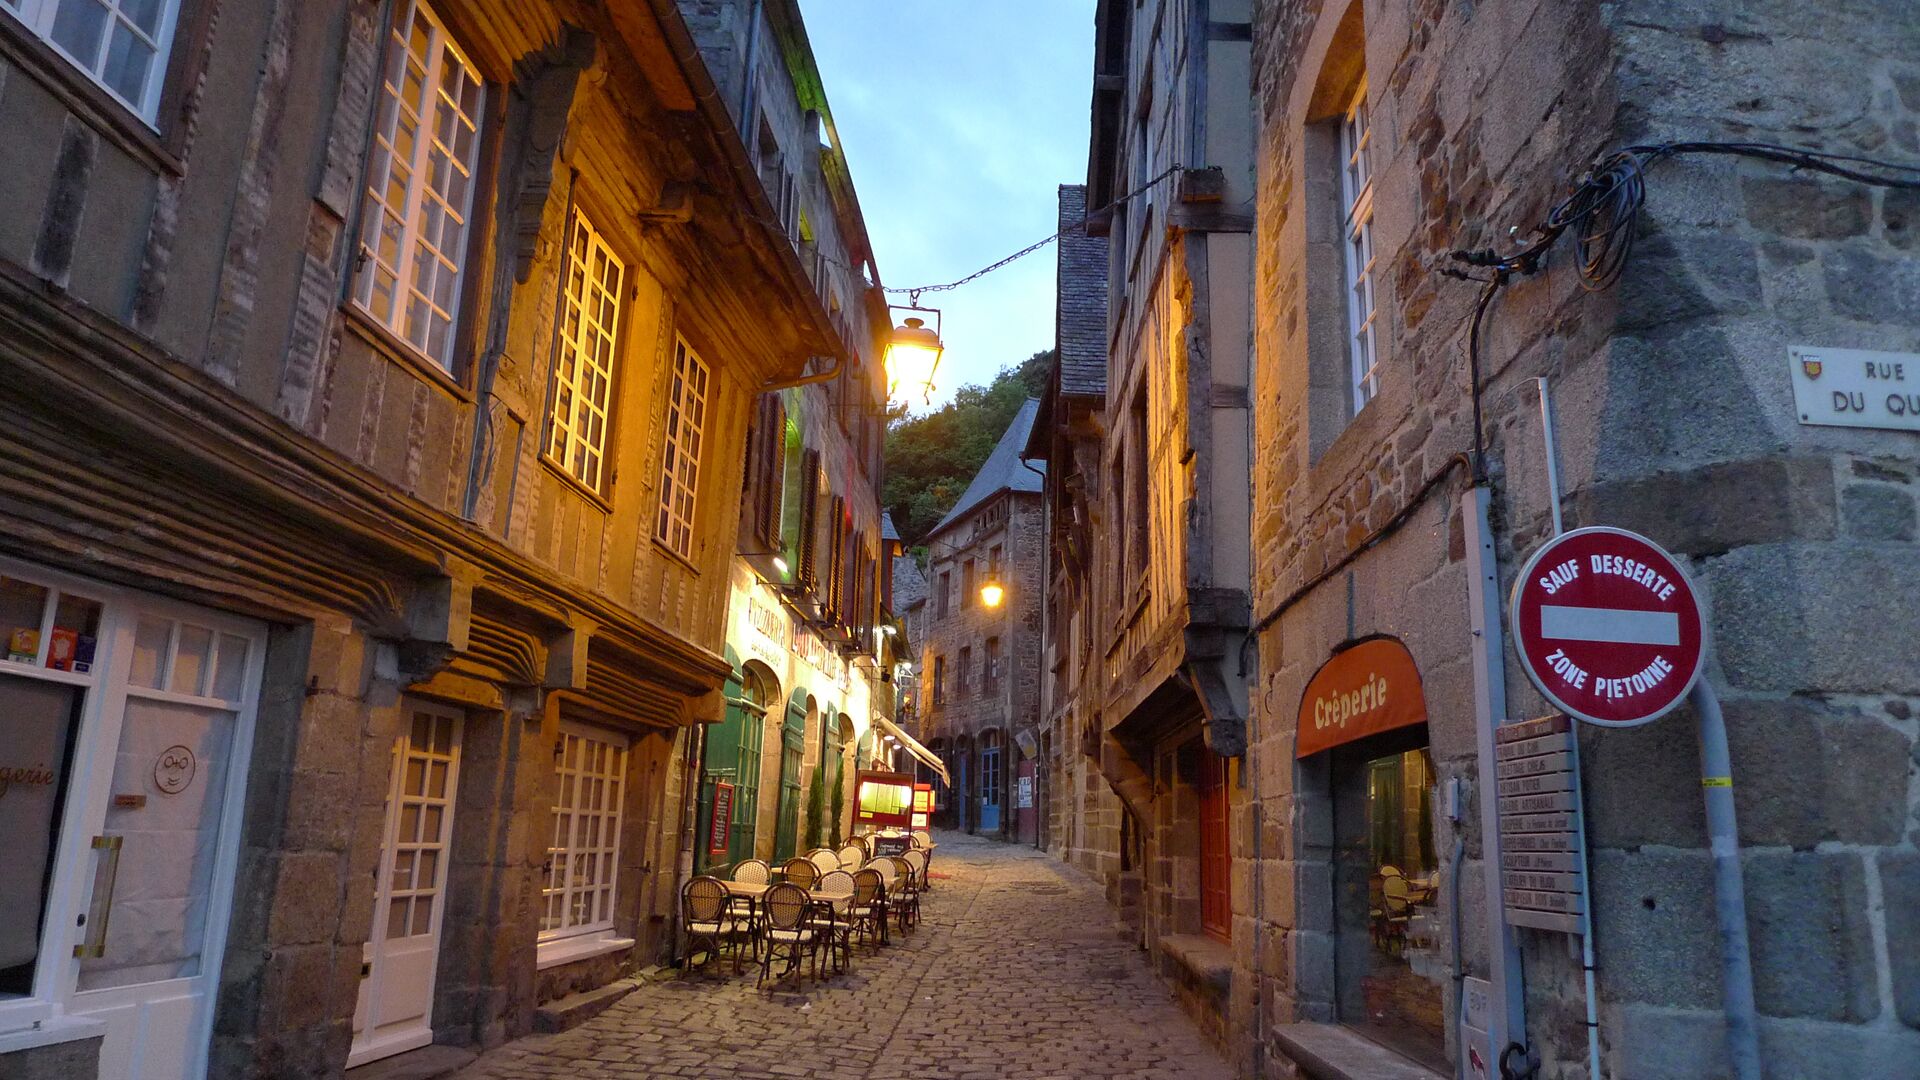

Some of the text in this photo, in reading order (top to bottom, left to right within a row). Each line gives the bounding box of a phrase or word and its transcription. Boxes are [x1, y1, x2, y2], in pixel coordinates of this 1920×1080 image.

[1865, 361, 1904, 381] RUE
[1832, 390, 1865, 413] DU
[1539, 554, 1677, 602] SAUF DESSERTE
[1545, 648, 1675, 698] ZONE PIETONNE
[1314, 671, 1387, 730] Crêperie
